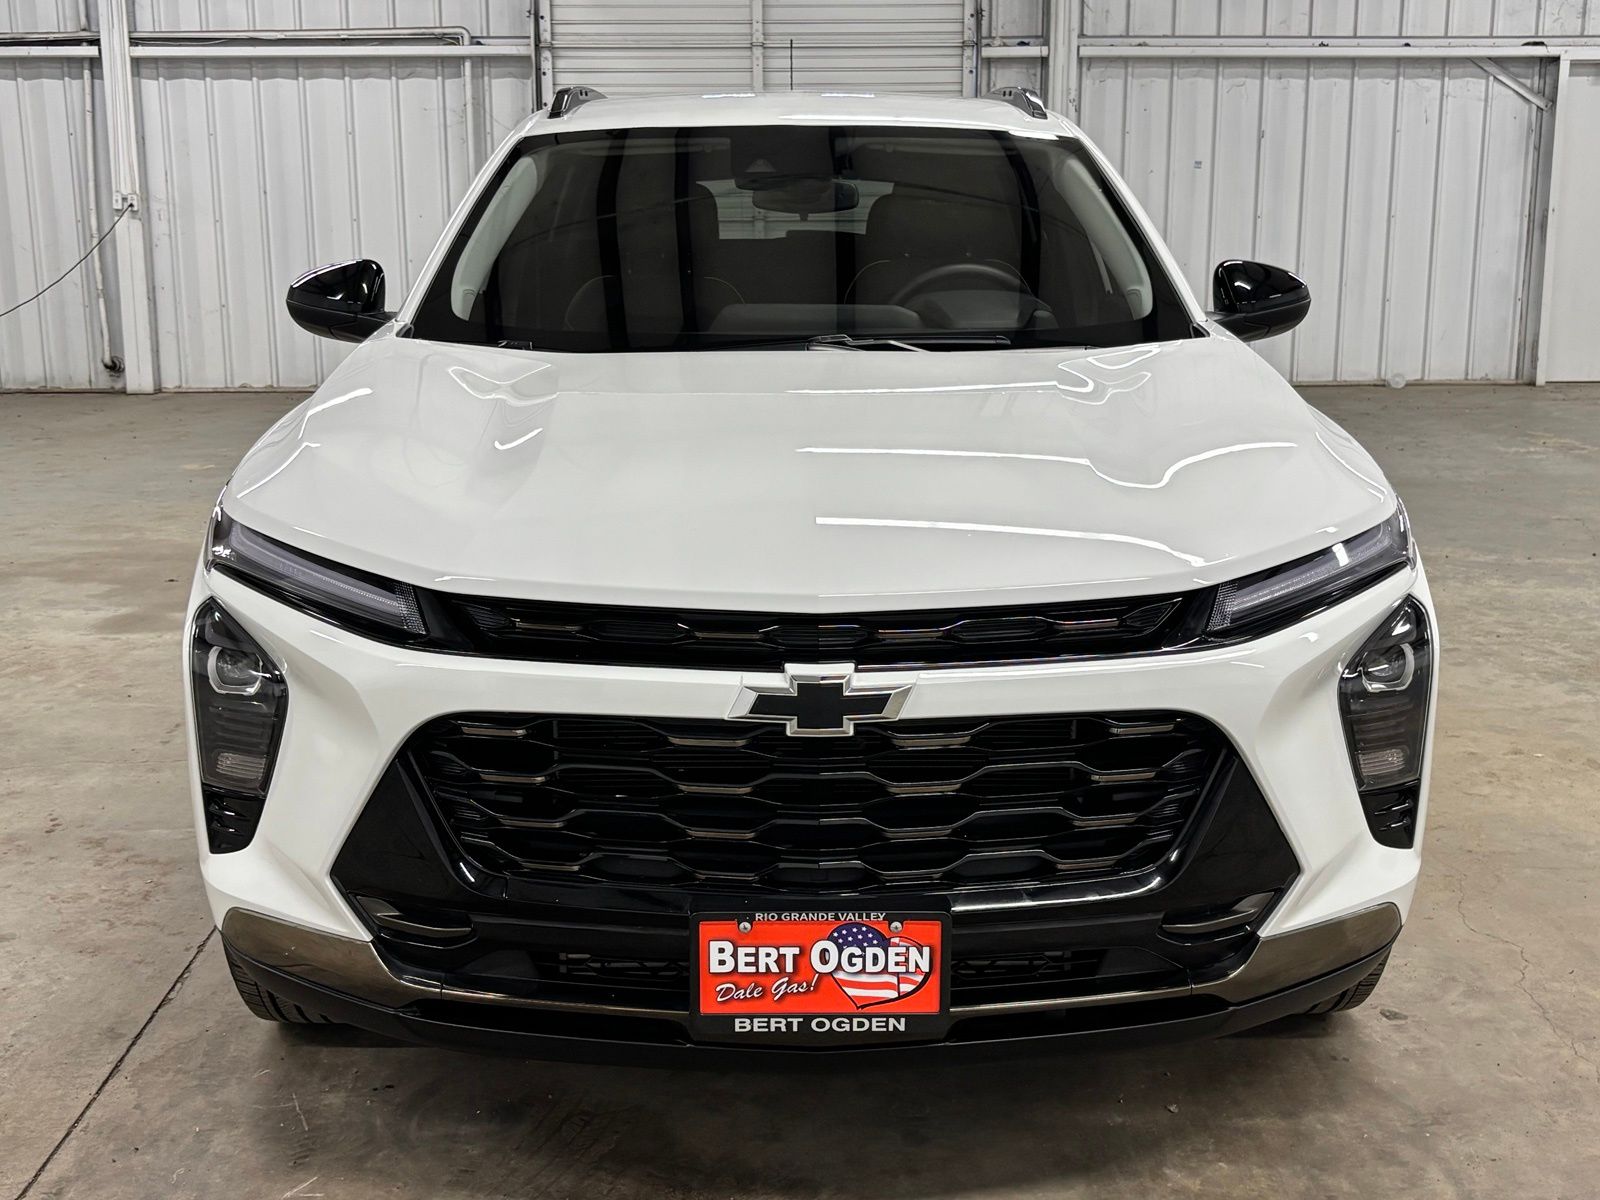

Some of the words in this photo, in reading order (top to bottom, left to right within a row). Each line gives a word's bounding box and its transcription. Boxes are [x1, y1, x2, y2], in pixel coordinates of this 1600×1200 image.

[755, 912, 778, 921] RIO
[781, 912, 836, 921] GRANDE
[838, 912, 886, 921] VALLEY
[709, 940, 800, 973] BERT
[810, 940, 930, 973] OGDEN
[715, 982, 763, 1002] Dale
[771, 973, 819, 1001] Gas!
[734, 1018, 803, 1032] BERT
[810, 1017, 906, 1032] OGDEN
